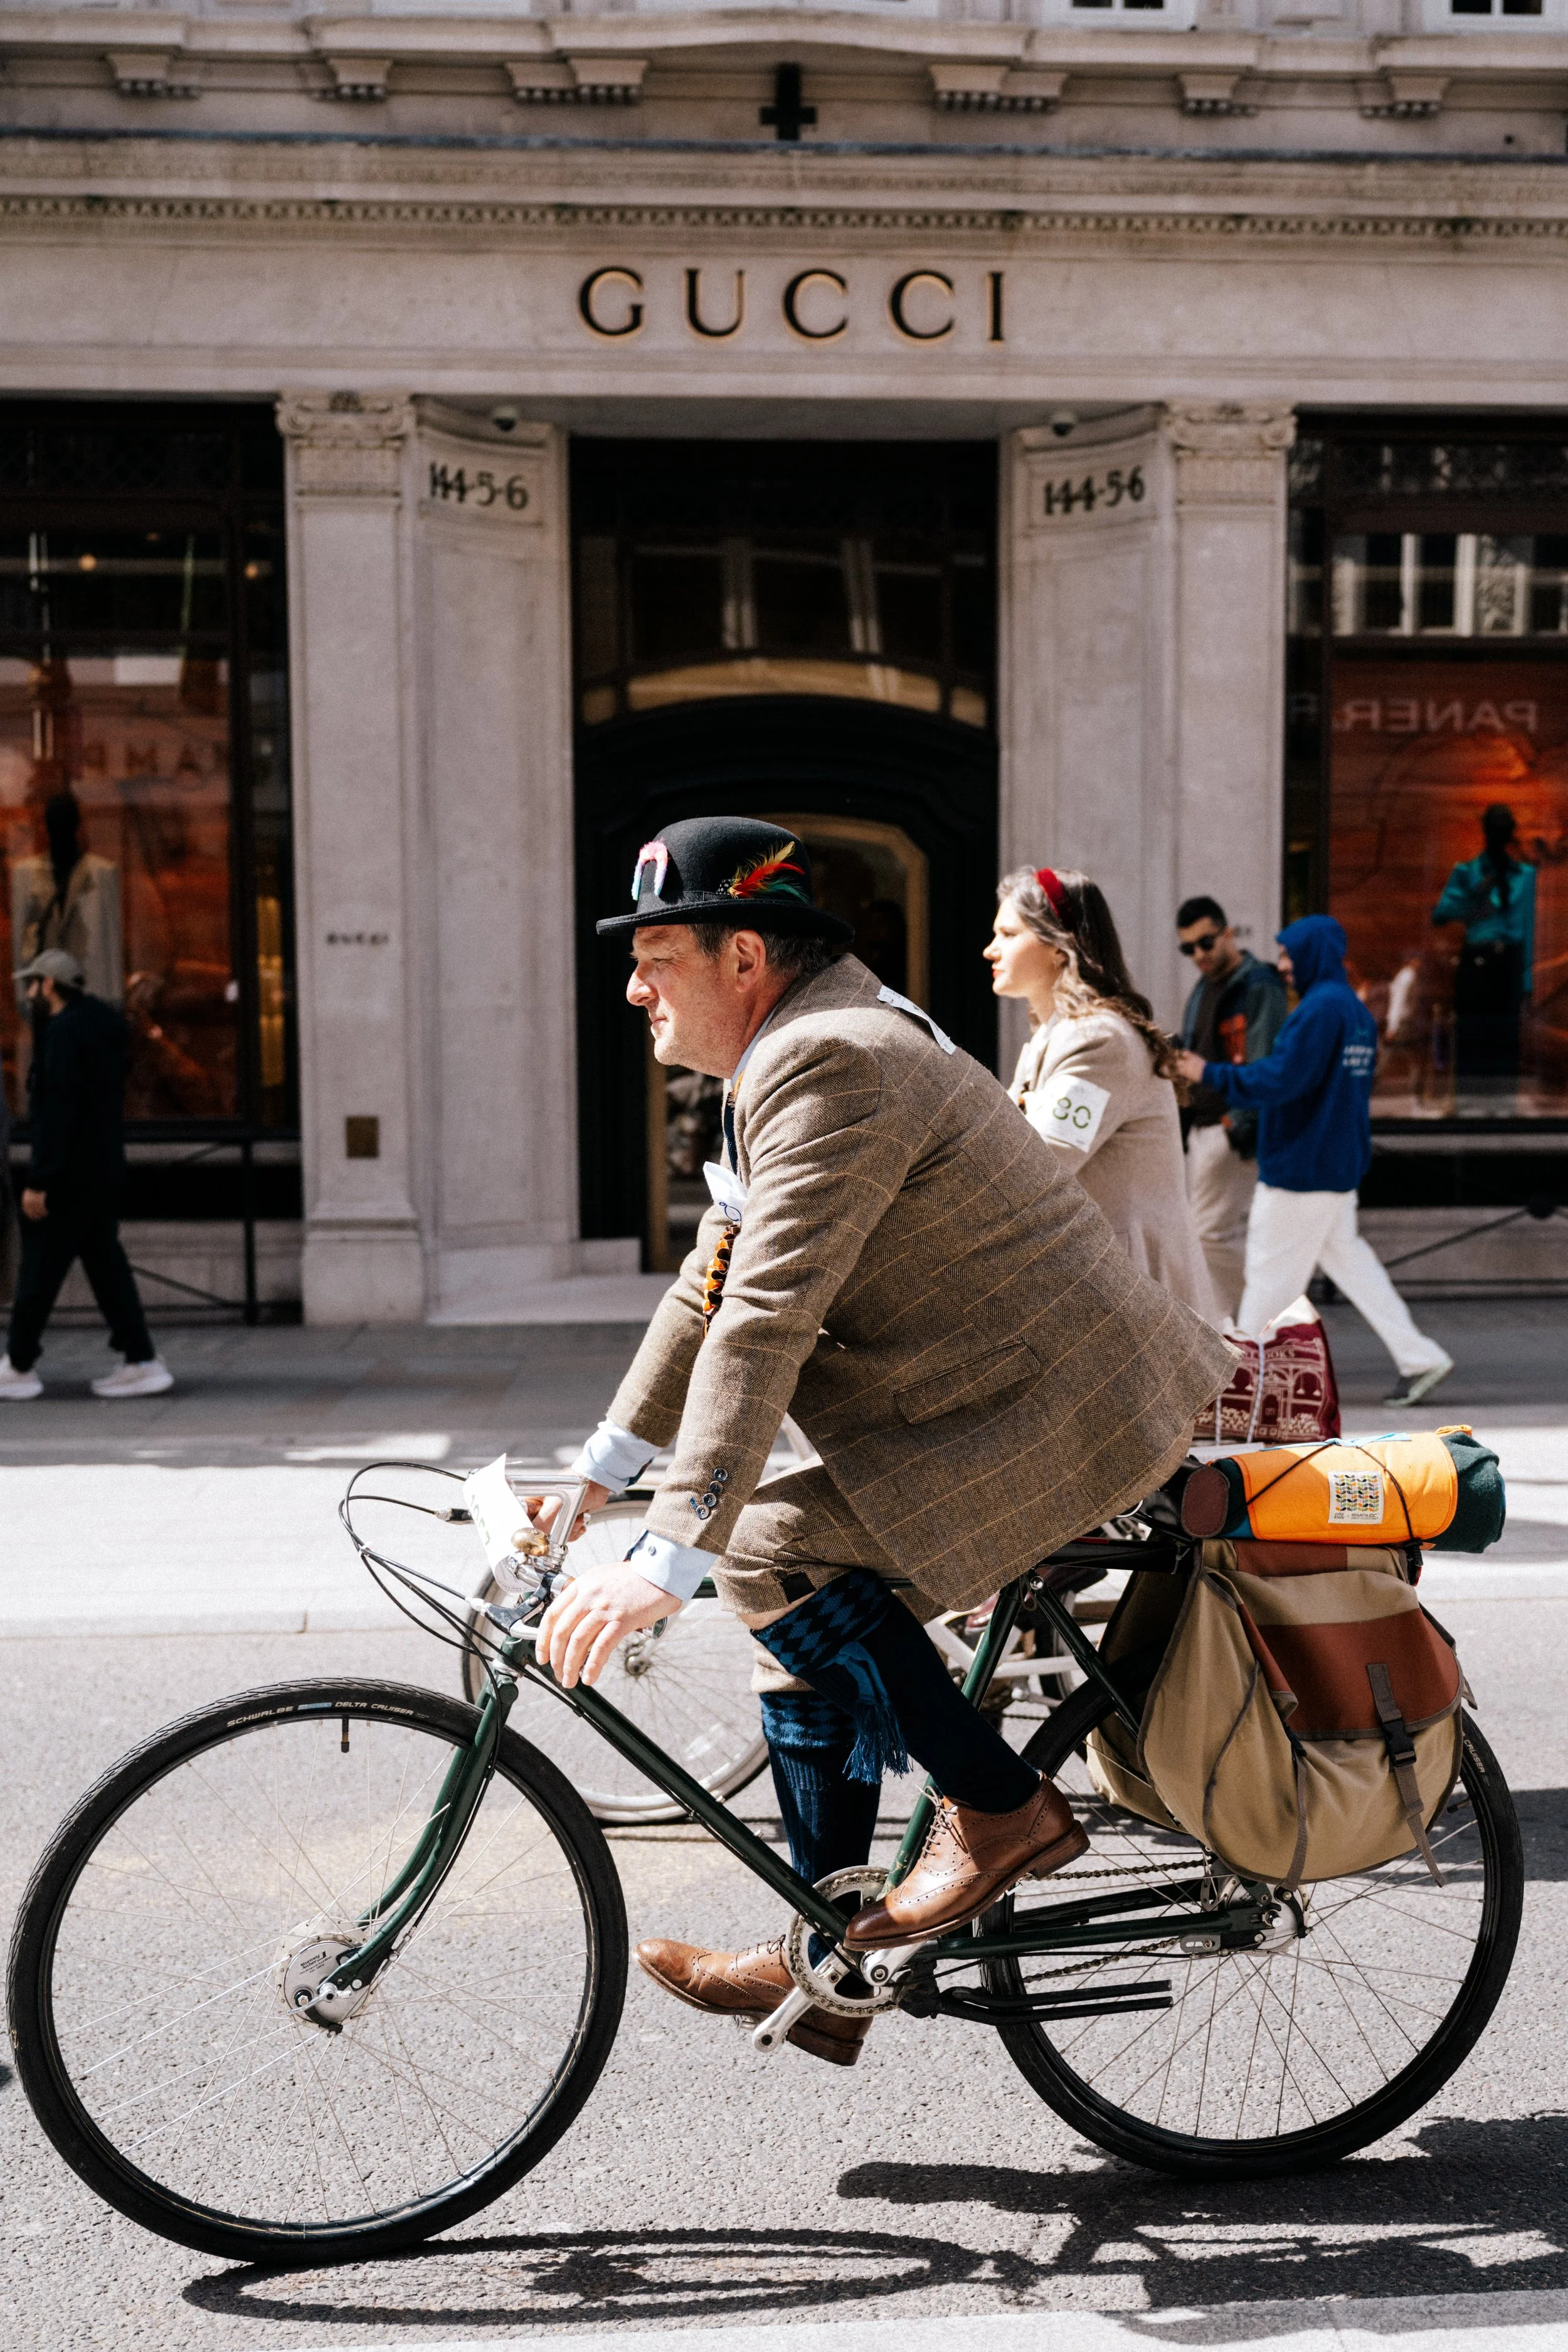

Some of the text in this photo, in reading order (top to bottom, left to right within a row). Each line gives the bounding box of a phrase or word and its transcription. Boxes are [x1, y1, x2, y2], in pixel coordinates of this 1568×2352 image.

[578, 266, 1005, 343] GUCCI
[226, 1706, 294, 1727] SCHWALBE
[371, 1703, 414, 1715] CRUISER
[1464, 1739, 1485, 1772] CRUISER
